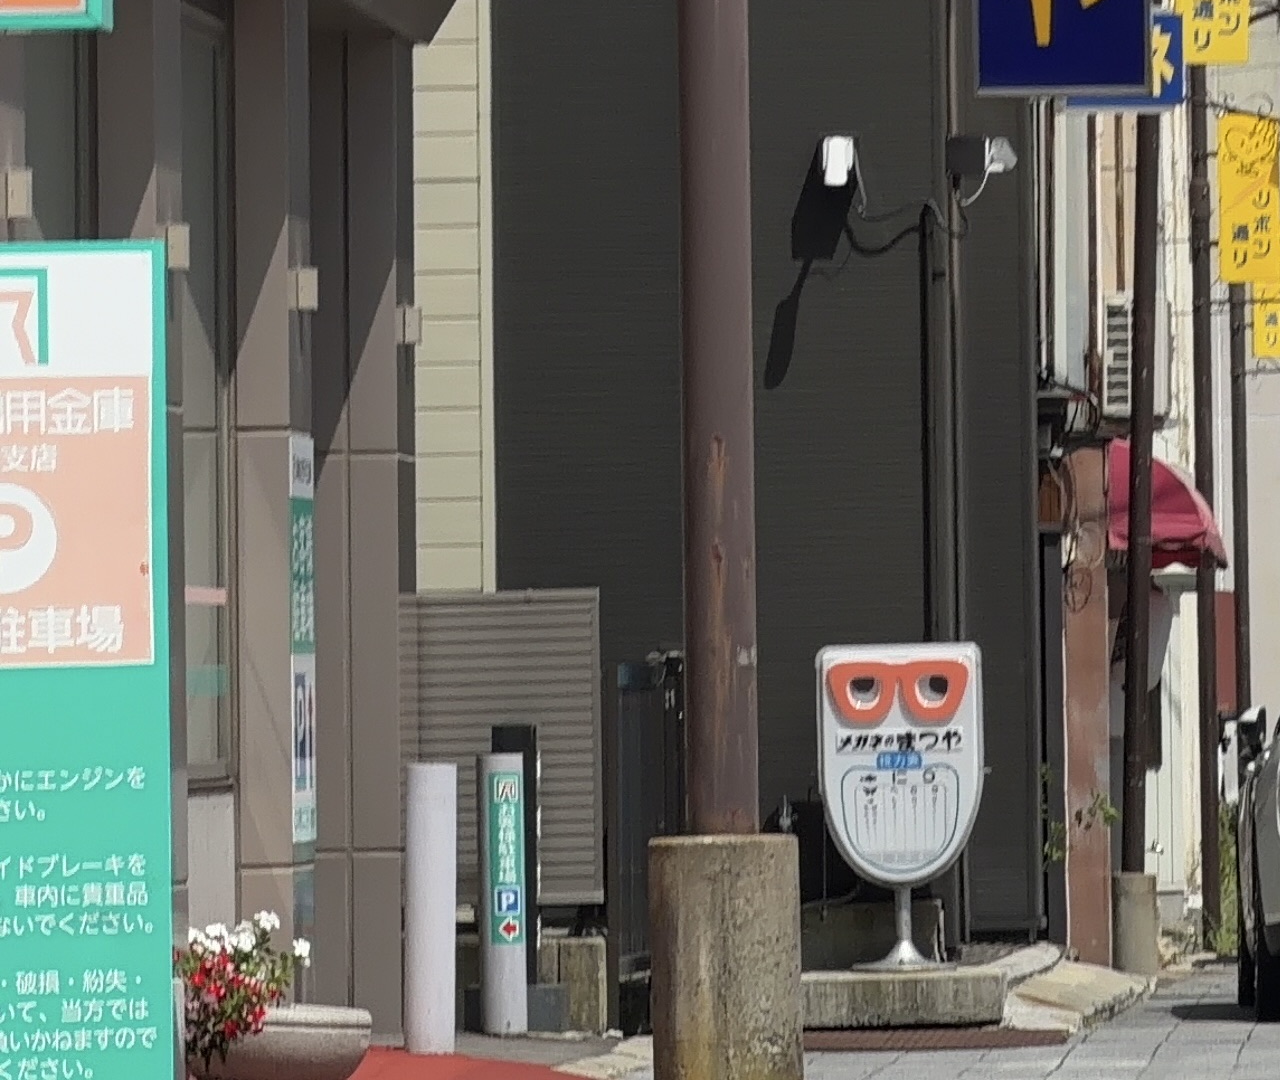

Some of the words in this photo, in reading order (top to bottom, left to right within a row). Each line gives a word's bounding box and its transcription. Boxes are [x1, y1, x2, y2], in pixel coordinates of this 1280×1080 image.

[1231, 222, 1250, 269] 通り
[1252, 189, 1271, 260] リボン
[0, 386, 135, 436] 用金庫
